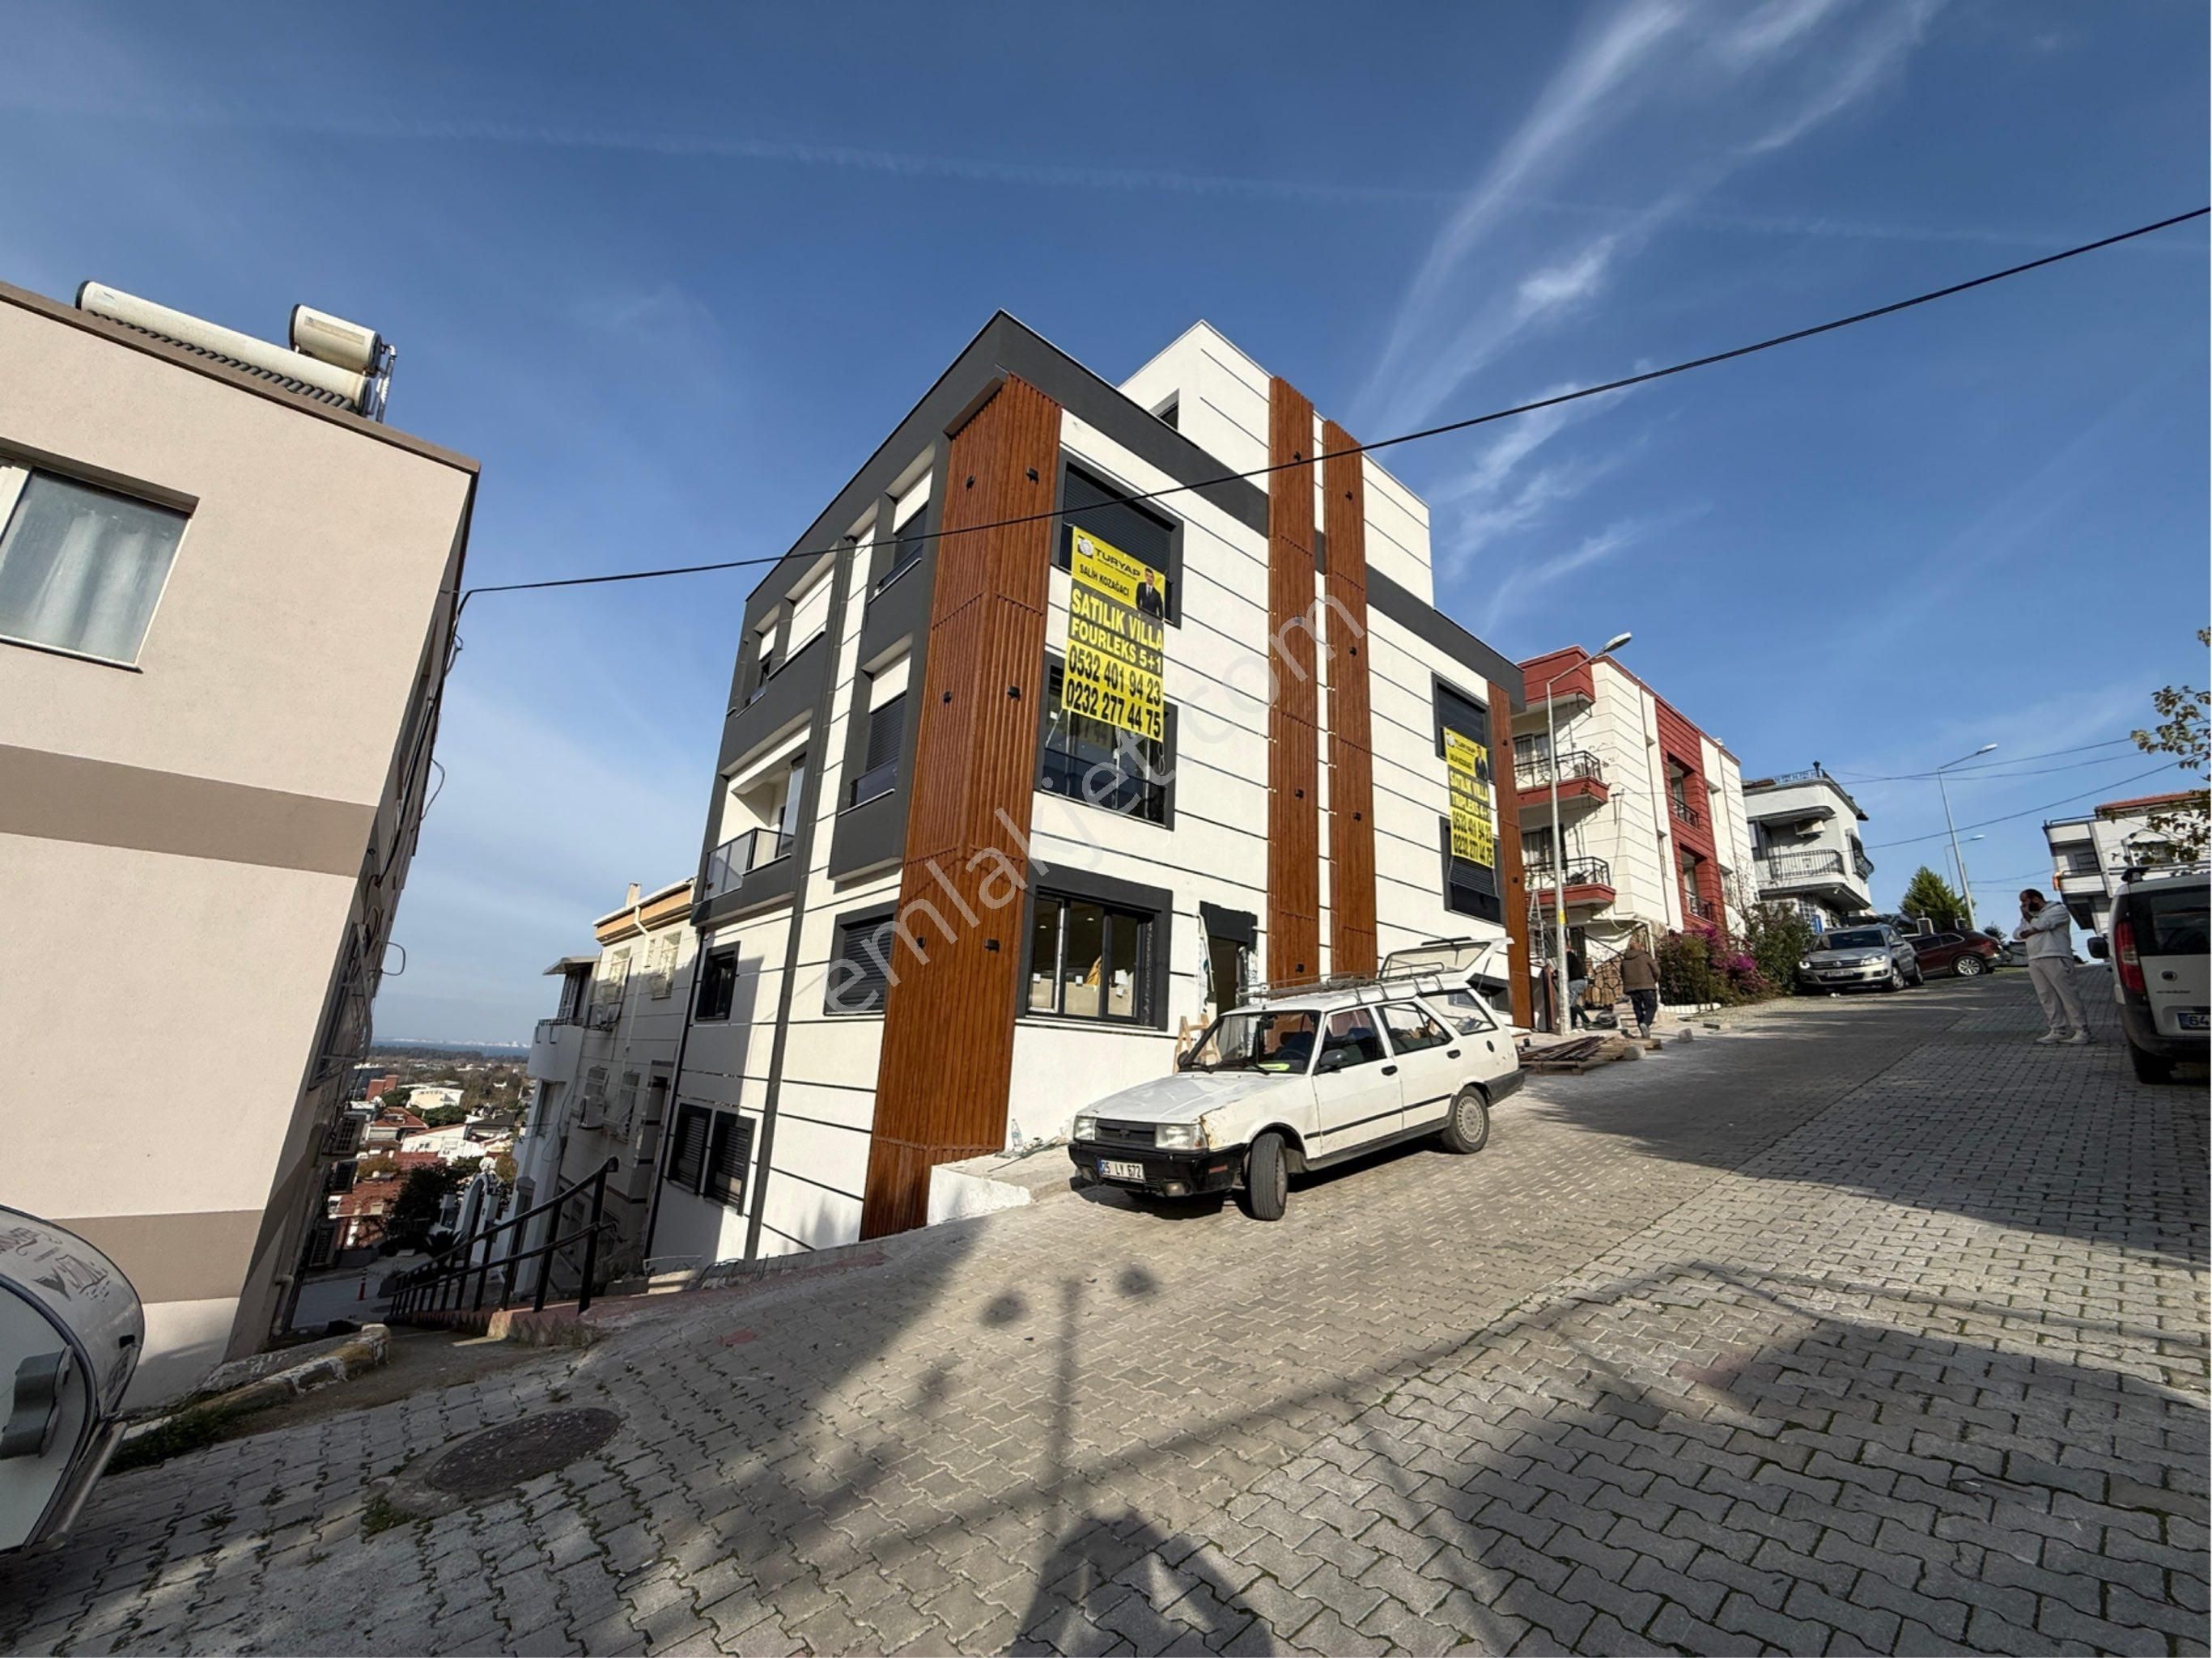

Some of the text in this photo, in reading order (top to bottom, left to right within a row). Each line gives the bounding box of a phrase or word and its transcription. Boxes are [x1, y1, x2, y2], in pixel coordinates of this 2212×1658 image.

[1094, 548, 1140, 577] TURYAP
[1071, 617, 1162, 673] FOURLEKS 5+1
[1072, 587, 1163, 652] SATILIK VİLLA
[1068, 644, 1161, 707] 0532 401 94 23
[1066, 677, 1098, 716] 0232
[1102, 693, 1125, 725] 277
[1127, 703, 1142, 732] 44
[1146, 710, 1161, 739] 75
